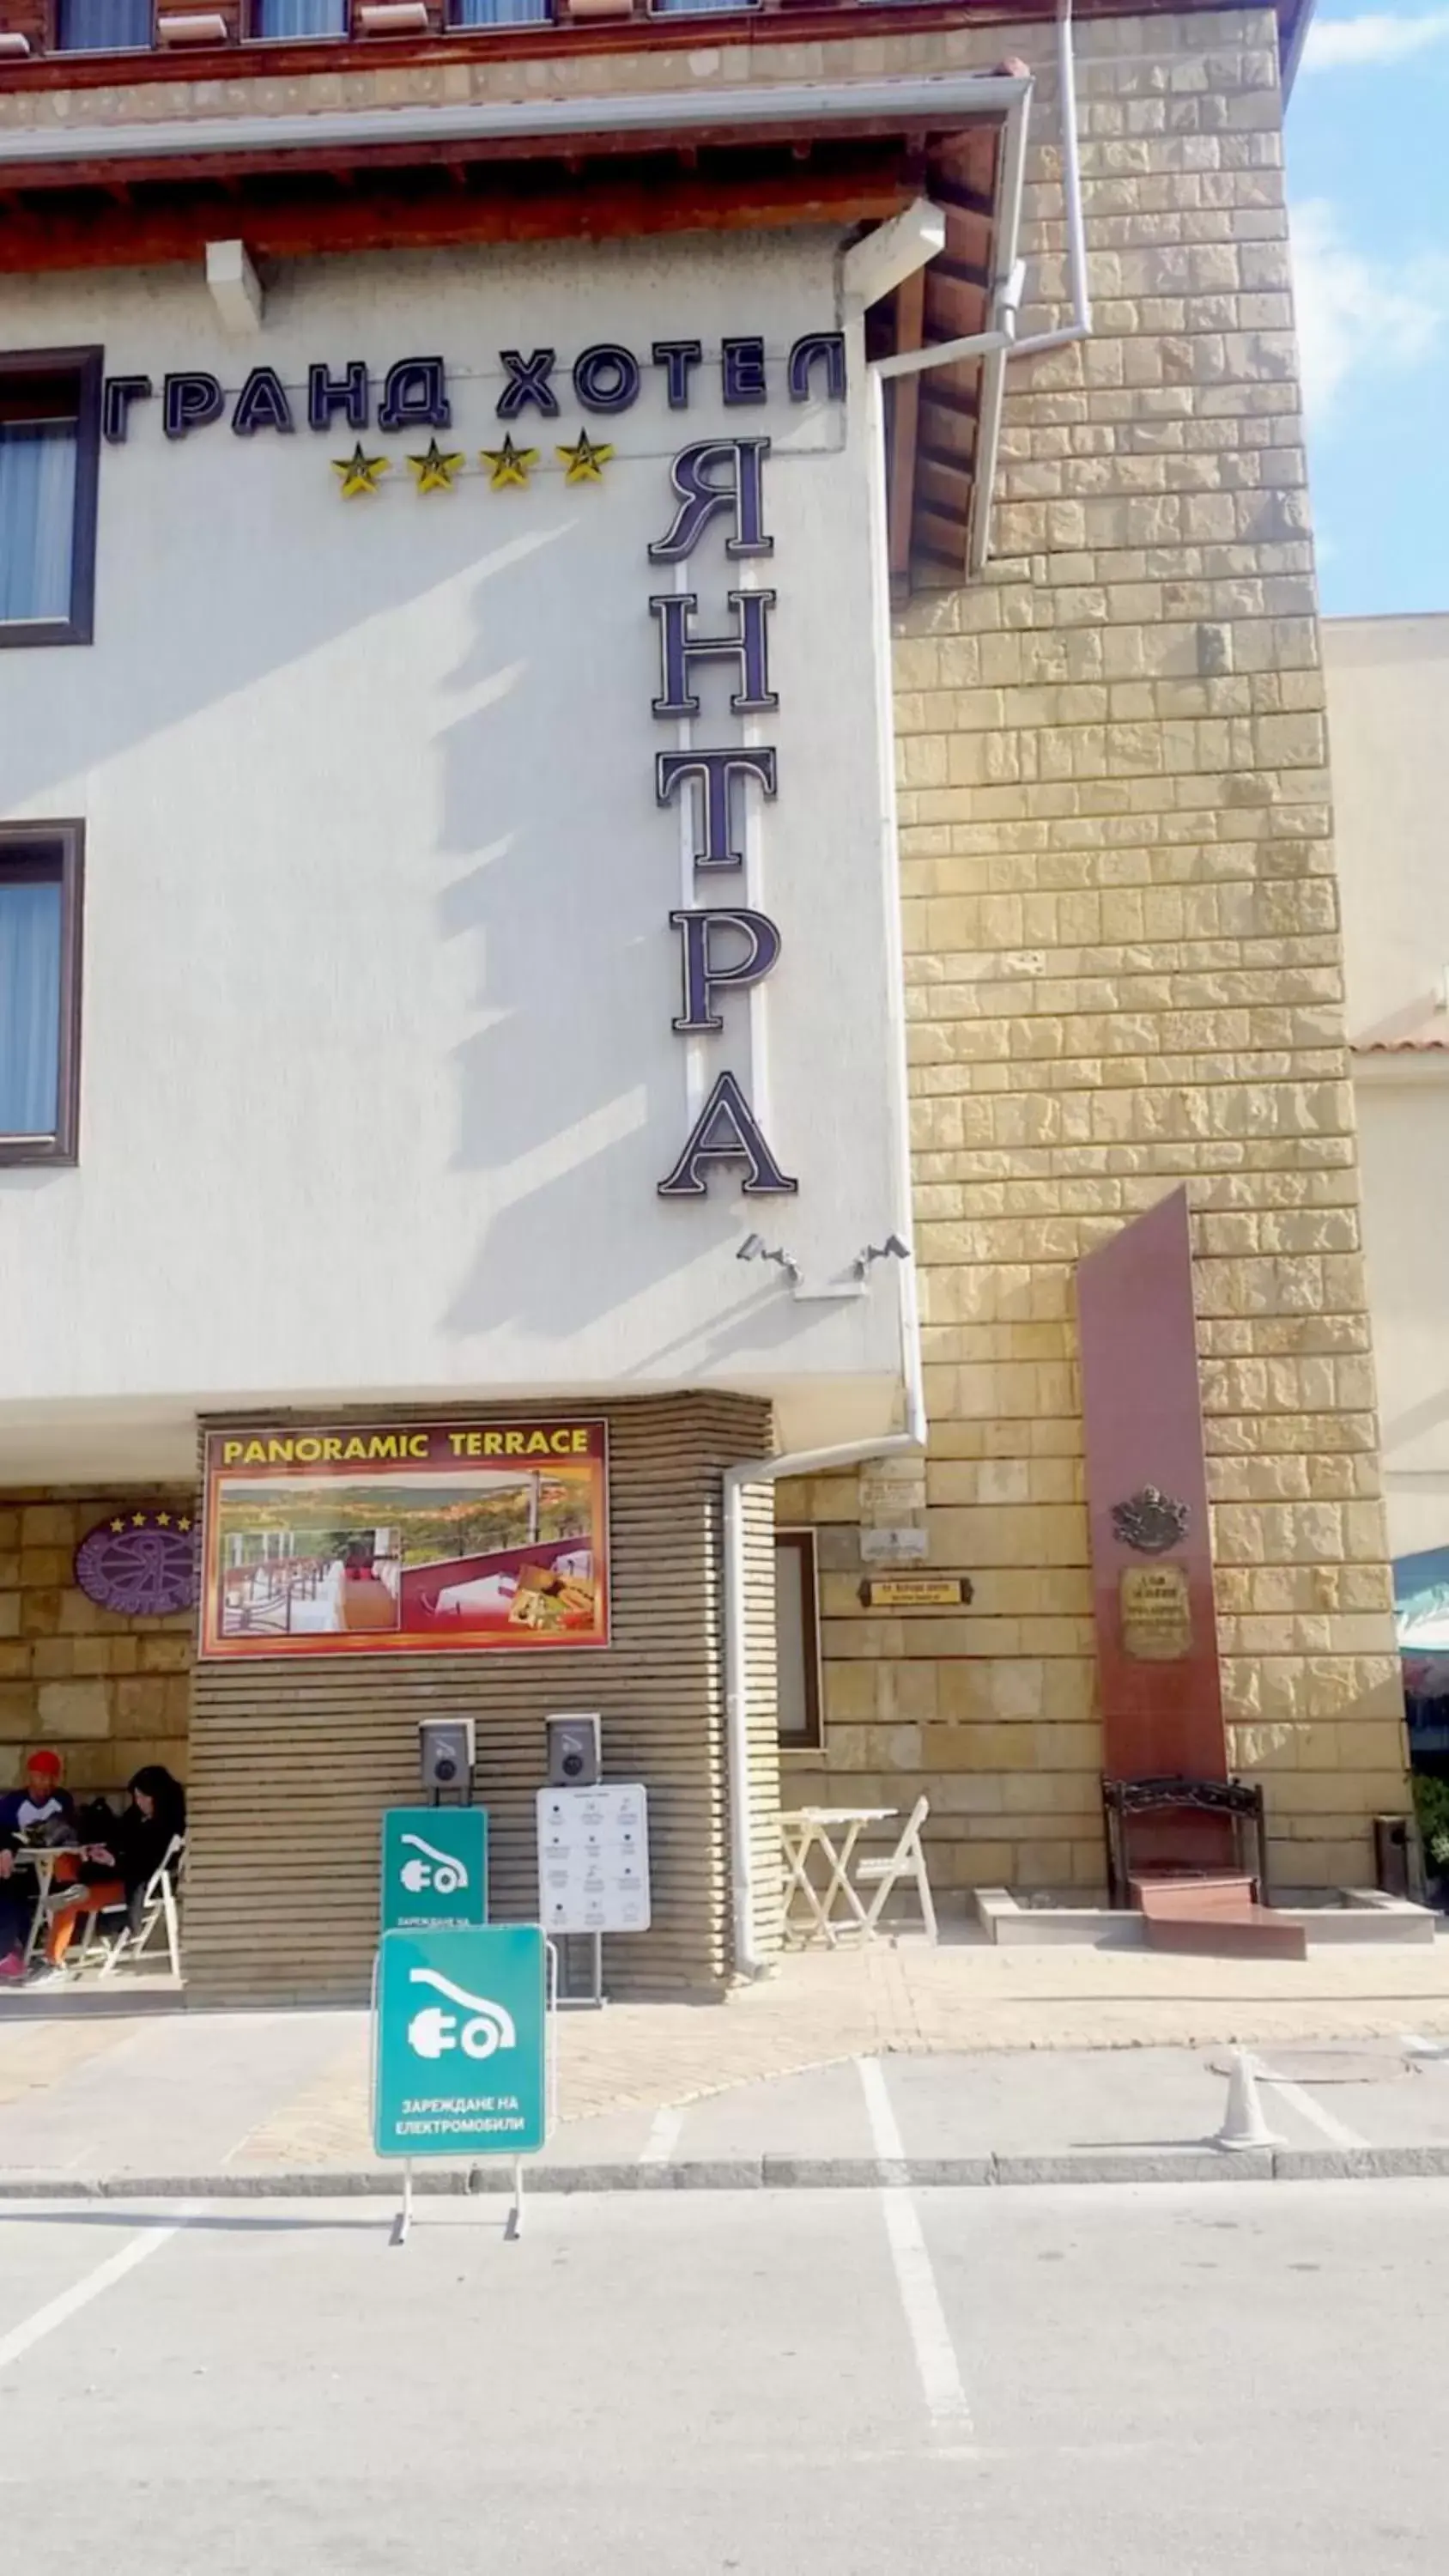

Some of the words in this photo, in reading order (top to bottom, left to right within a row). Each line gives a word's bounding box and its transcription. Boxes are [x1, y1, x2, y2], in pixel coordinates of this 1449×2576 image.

[102, 355, 452, 443] ГРАНД
[497, 331, 846, 418] ХОТЕЛ
[648, 436, 798, 1196] ЯНТРА
[223, 1434, 428, 1464] PANORAMIC
[450, 1428, 588, 1457] TERRACE
[402, 2096, 494, 2115] ЗАРЕЖДАНЕ
[497, 2095, 518, 2110] НА
[395, 2117, 525, 2136] ЕЛЕКТРОМОБИЛИ
